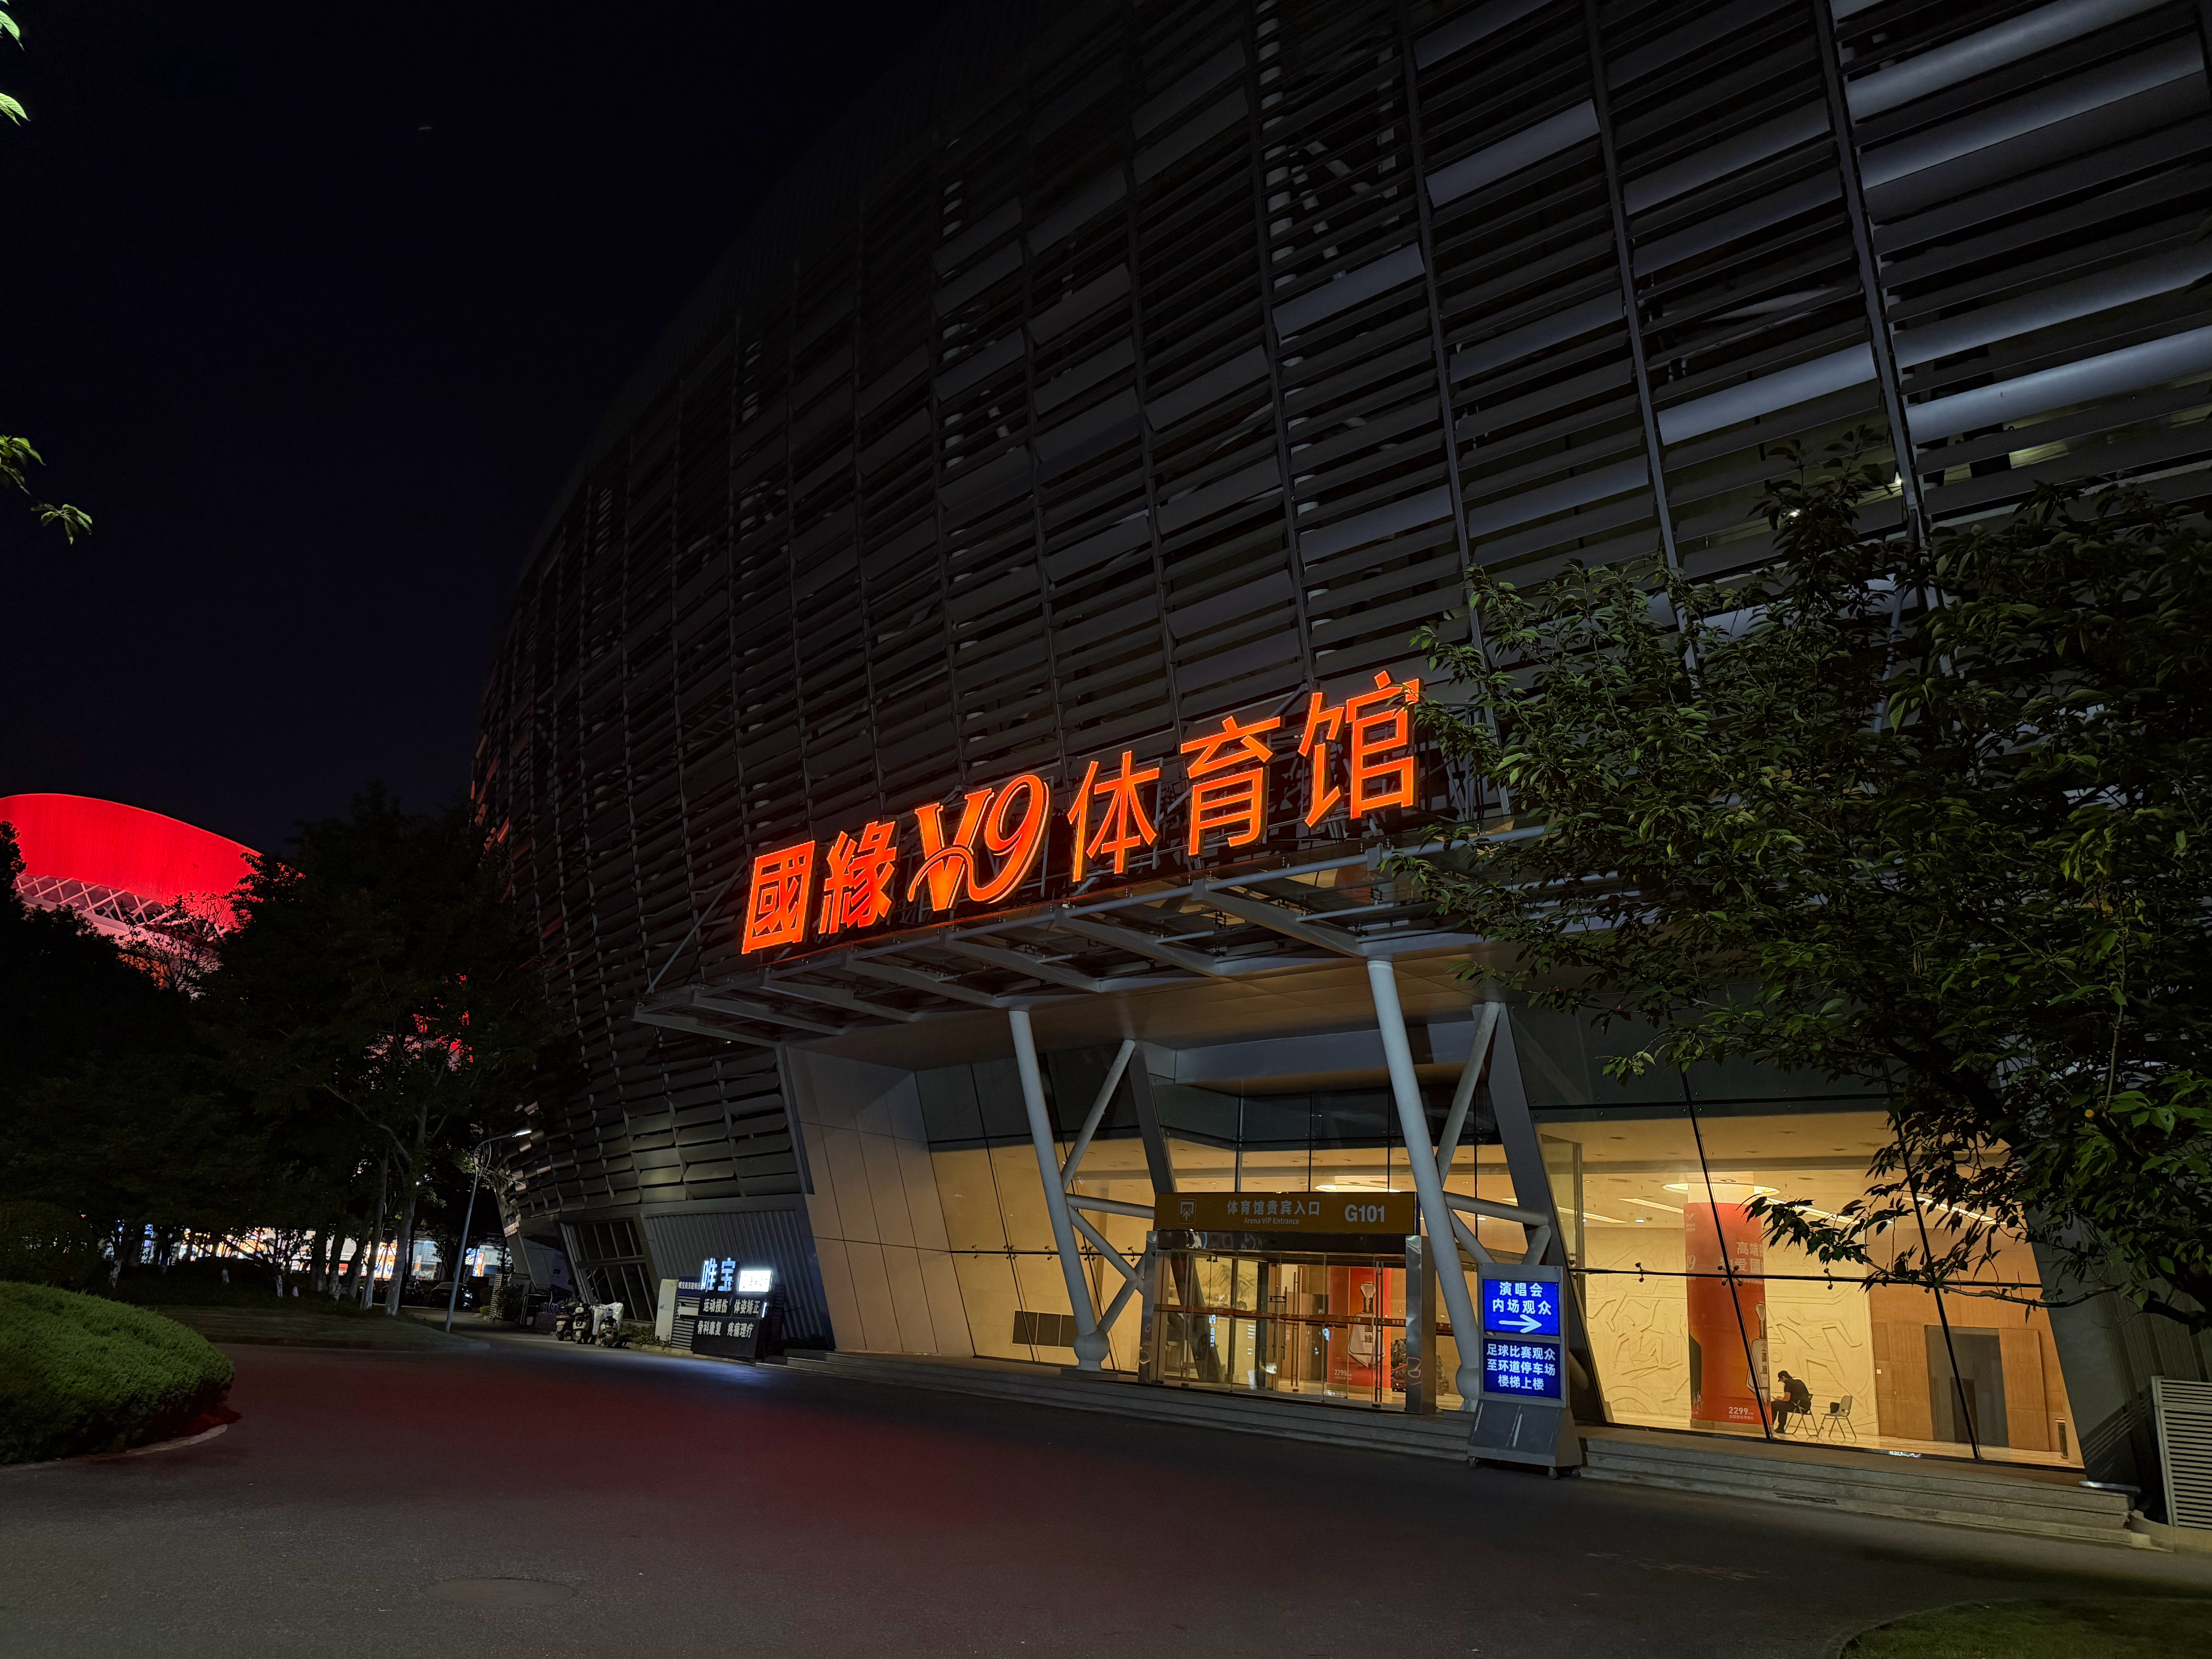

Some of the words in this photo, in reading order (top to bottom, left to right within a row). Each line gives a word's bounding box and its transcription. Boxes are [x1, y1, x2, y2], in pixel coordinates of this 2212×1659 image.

[1227, 1200, 1320, 1216] 体育馆贵宾入口
[1345, 1204, 1385, 1223] G101
[700, 1257, 736, 1291] 唯宝
[1499, 1282, 1543, 1298] 演唱会
[703, 1298, 728, 1314] 运动损伤
[734, 1299, 760, 1315] 体姿矫正
[1492, 1298, 1552, 1316] 内场观众
[697, 1320, 722, 1336] 骨科康复
[727, 1321, 754, 1339] 疼痛理疗
[1486, 1343, 1556, 1361] 足球比赛观众
[1486, 1358, 1556, 1376] 至环道停车场
[1498, 1374, 1544, 1391] 楼梯上楼
[1728, 1406, 1748, 1415] 2299
